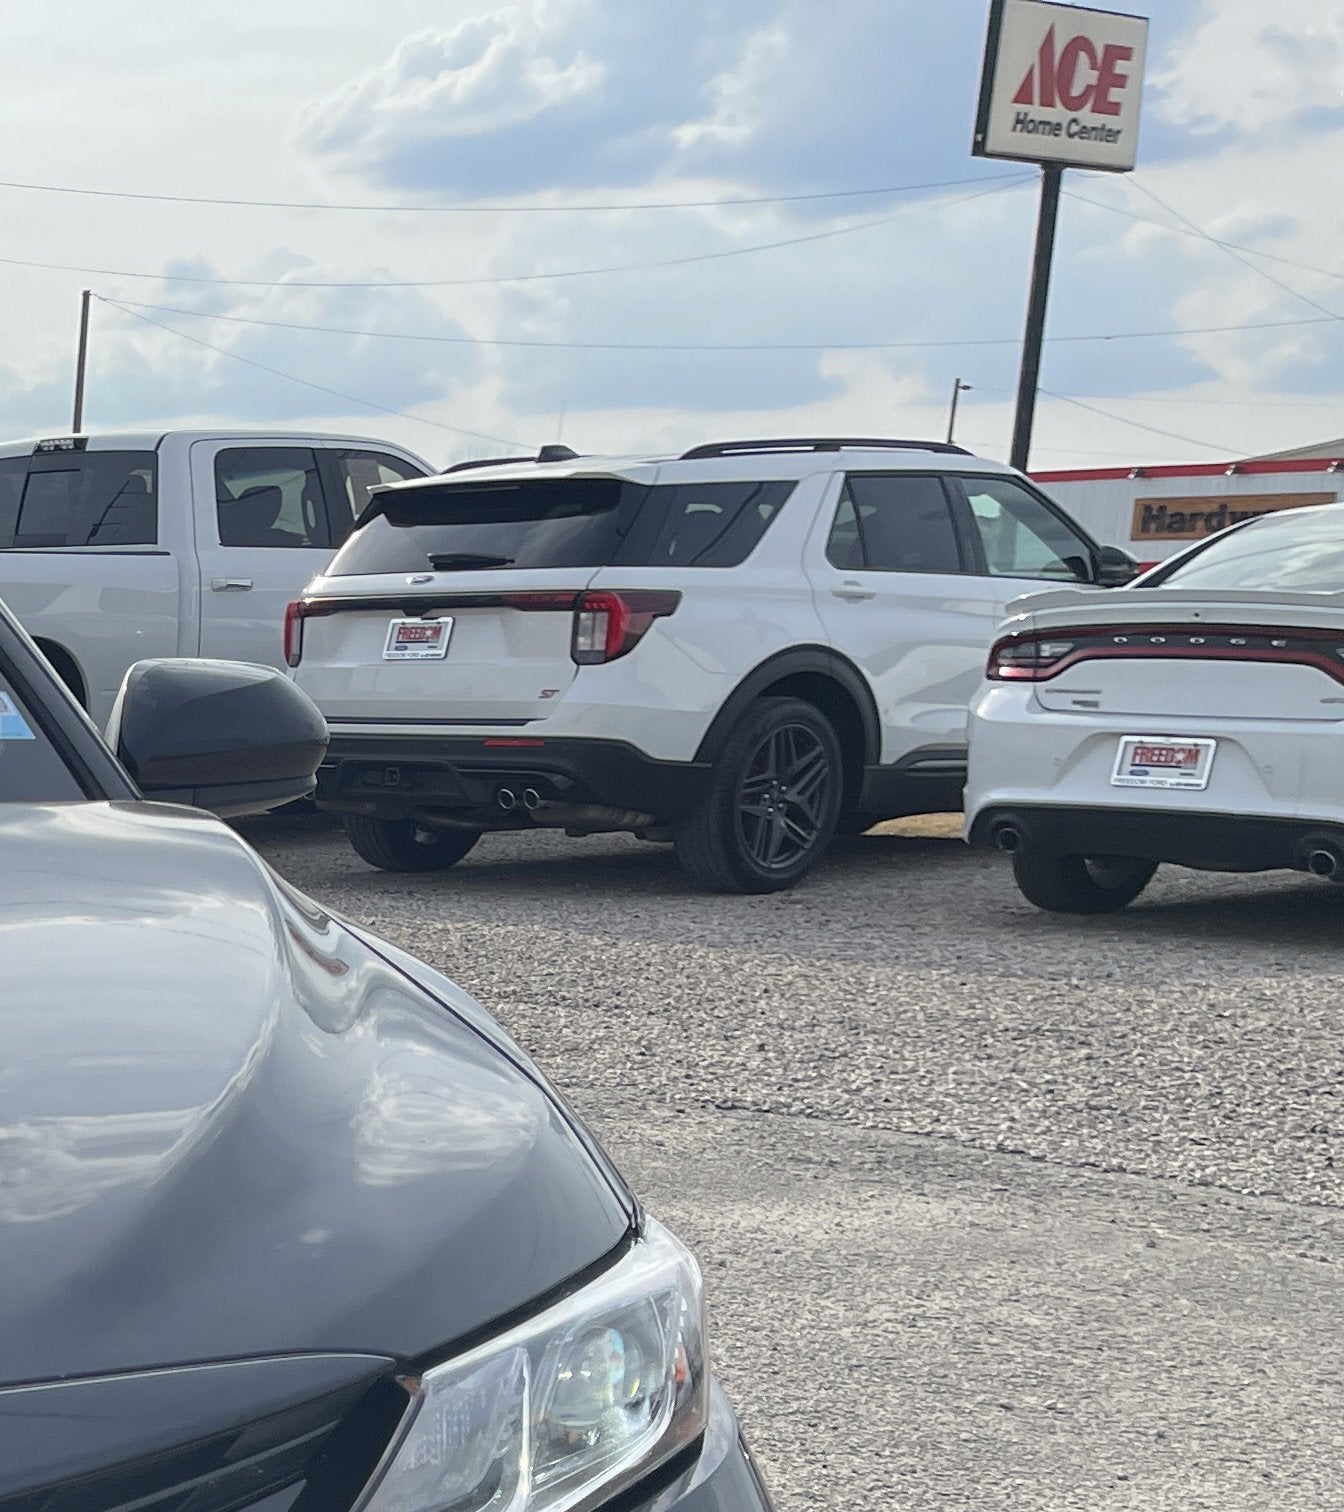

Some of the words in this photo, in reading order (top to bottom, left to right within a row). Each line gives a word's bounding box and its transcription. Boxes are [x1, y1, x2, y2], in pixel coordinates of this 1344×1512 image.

[1011, 21, 1134, 116] ACE
[1011, 111, 1062, 137] Home
[1066, 117, 1123, 144] Center
